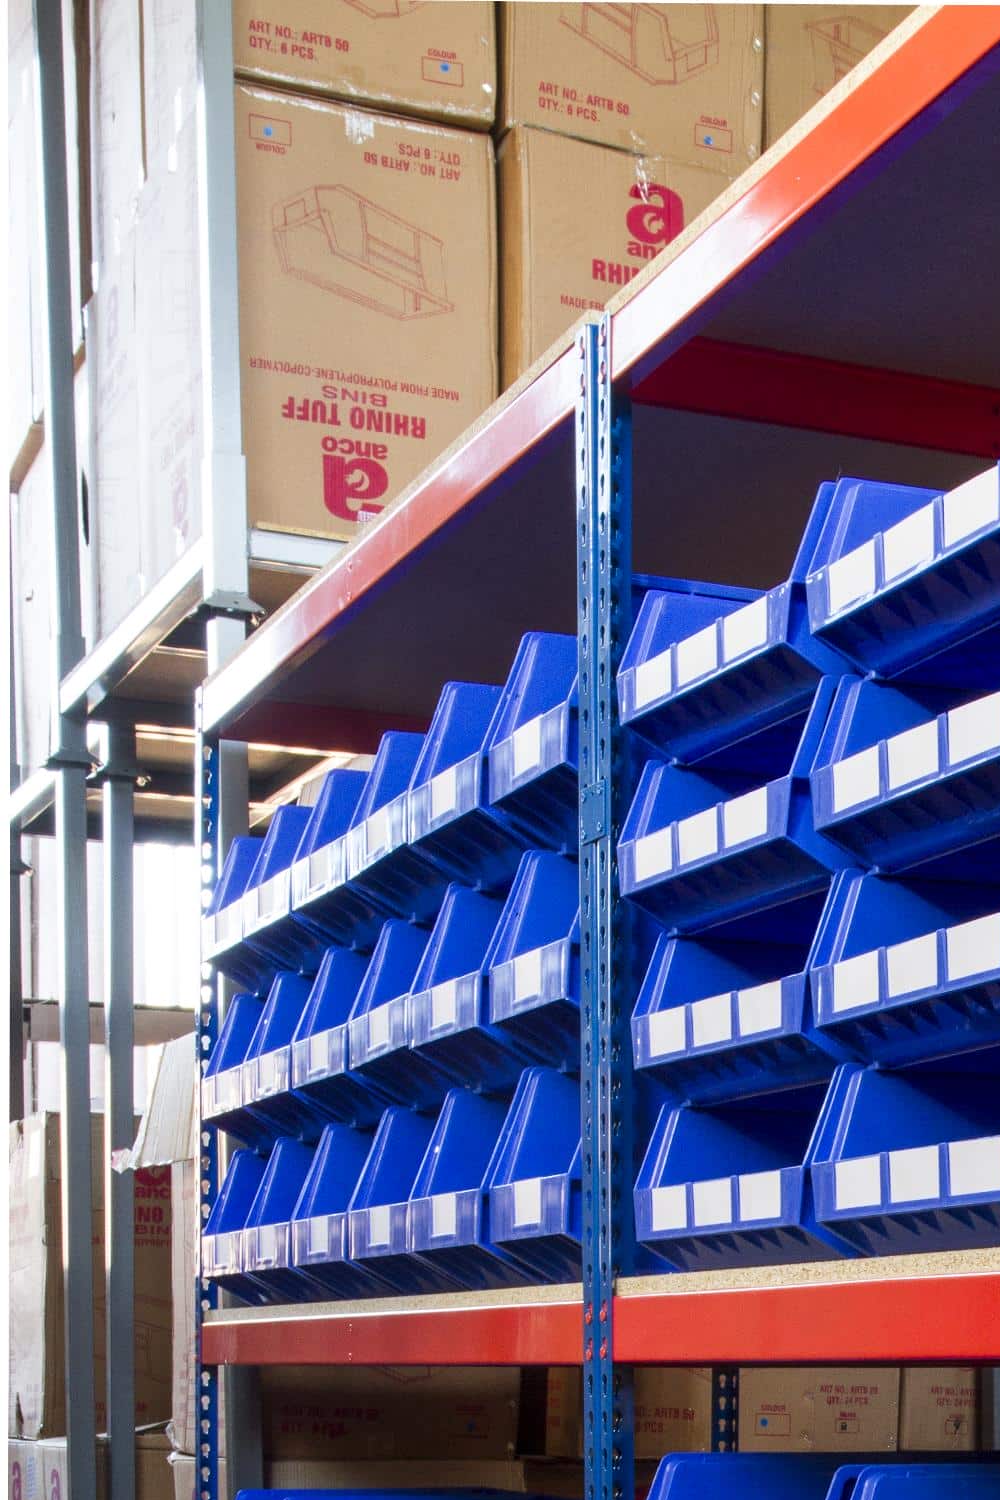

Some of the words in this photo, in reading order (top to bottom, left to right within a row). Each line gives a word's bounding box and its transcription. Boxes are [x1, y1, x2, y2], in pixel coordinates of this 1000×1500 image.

[249, 20, 270, 33] ART
[302, 31, 332, 47] ARTB
[335, 39, 350, 52] 50
[280, 42, 288, 54] 6
[538, 81, 558, 97] ART
[586, 94, 614, 111] ARTB
[567, 105, 573, 116] 6
[699, 115, 728, 128] COLOUR
[363, 151, 378, 165] 50
[424, 148, 431, 160] 6
[381, 154, 410, 172] ARTB
[439, 166, 461, 181] ART
[560, 295, 588, 310] MADE
[249, 357, 398, 392] POLYPROPYLENE-COPOLYMER
[321, 385, 388, 408] BINS
[400, 382, 429, 397] FROM
[432, 387, 460, 401] MADE
[281, 396, 341, 426] TUFF
[350, 406, 426, 439] RHINO
[321, 436, 389, 460] anco
[135, 1186, 172, 1200] anc
